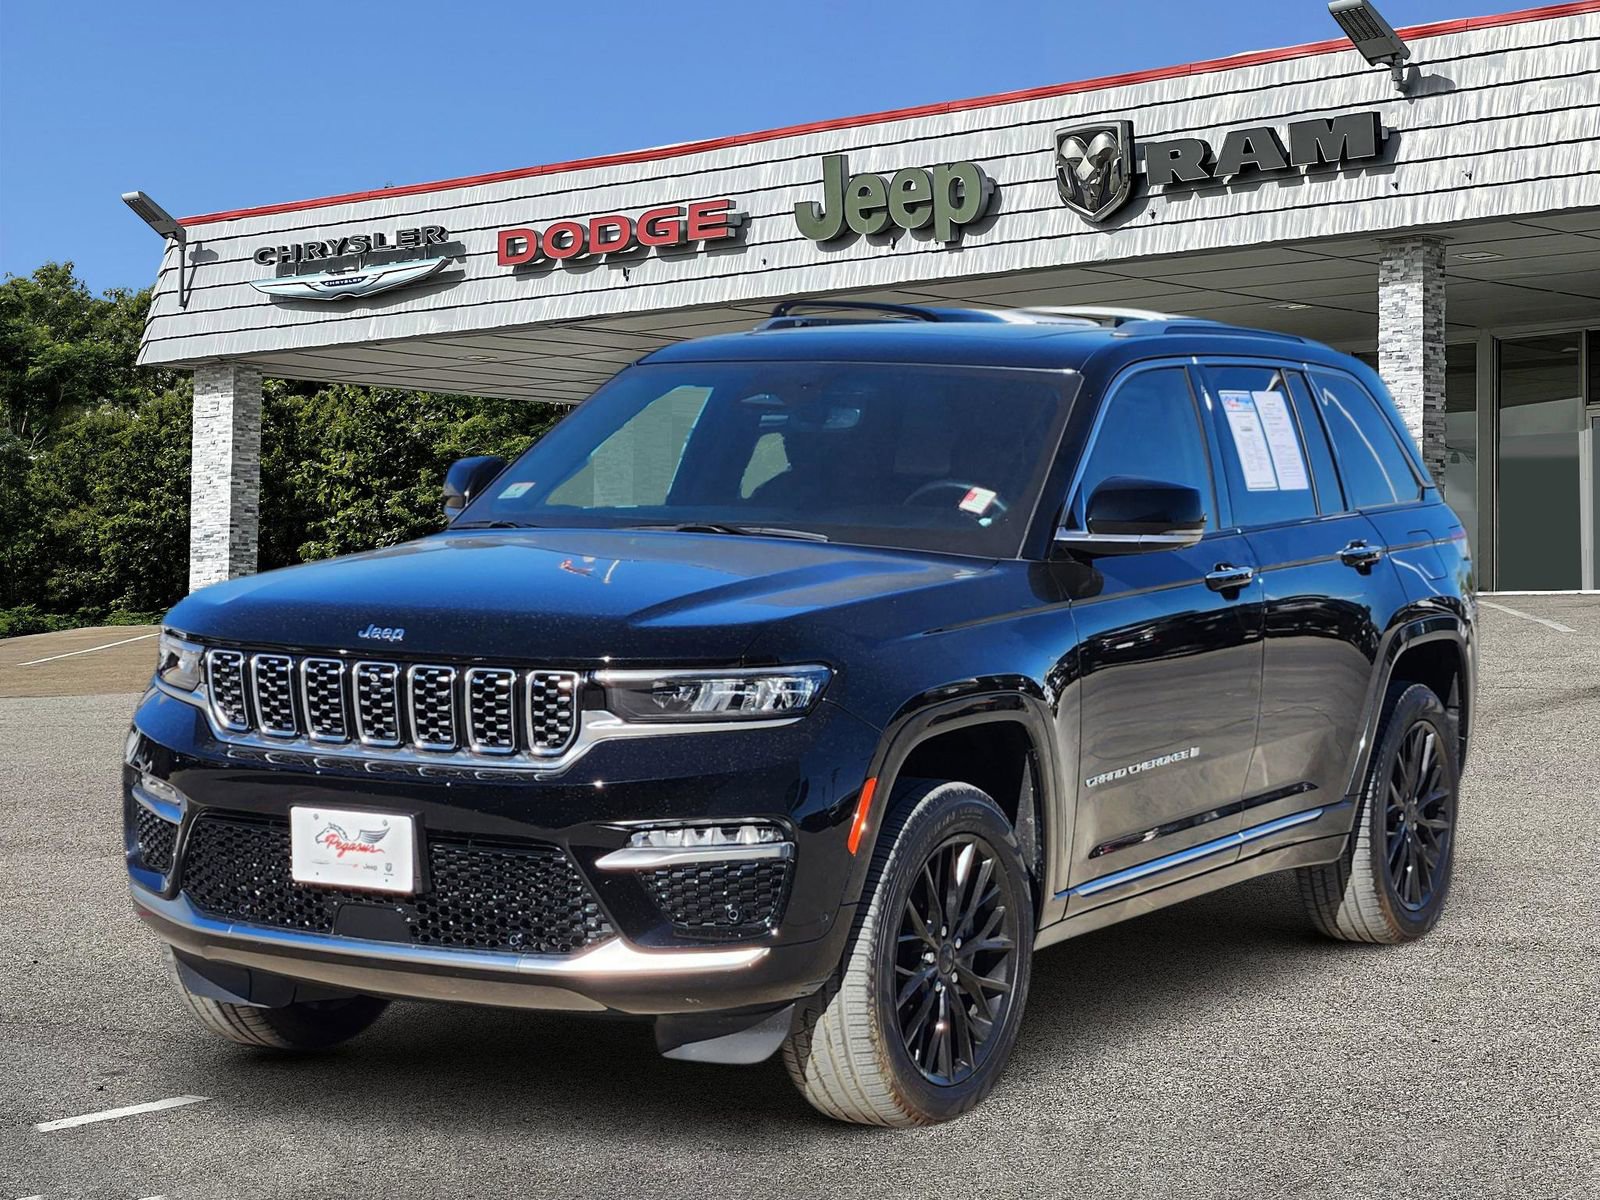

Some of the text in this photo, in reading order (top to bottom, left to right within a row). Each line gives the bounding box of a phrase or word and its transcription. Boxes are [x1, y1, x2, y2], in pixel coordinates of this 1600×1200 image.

[1146, 111, 1382, 187] RAM
[795, 154, 986, 242] Jeep
[253, 225, 449, 266] CHRYSLER
[497, 199, 733, 266] DODGE
[324, 278, 363, 286] CHRYSLER
[358, 623, 405, 642] Jeep
[1086, 750, 1190, 787] GRAND CHEROKEE
[325, 833, 385, 858] Pegasus
